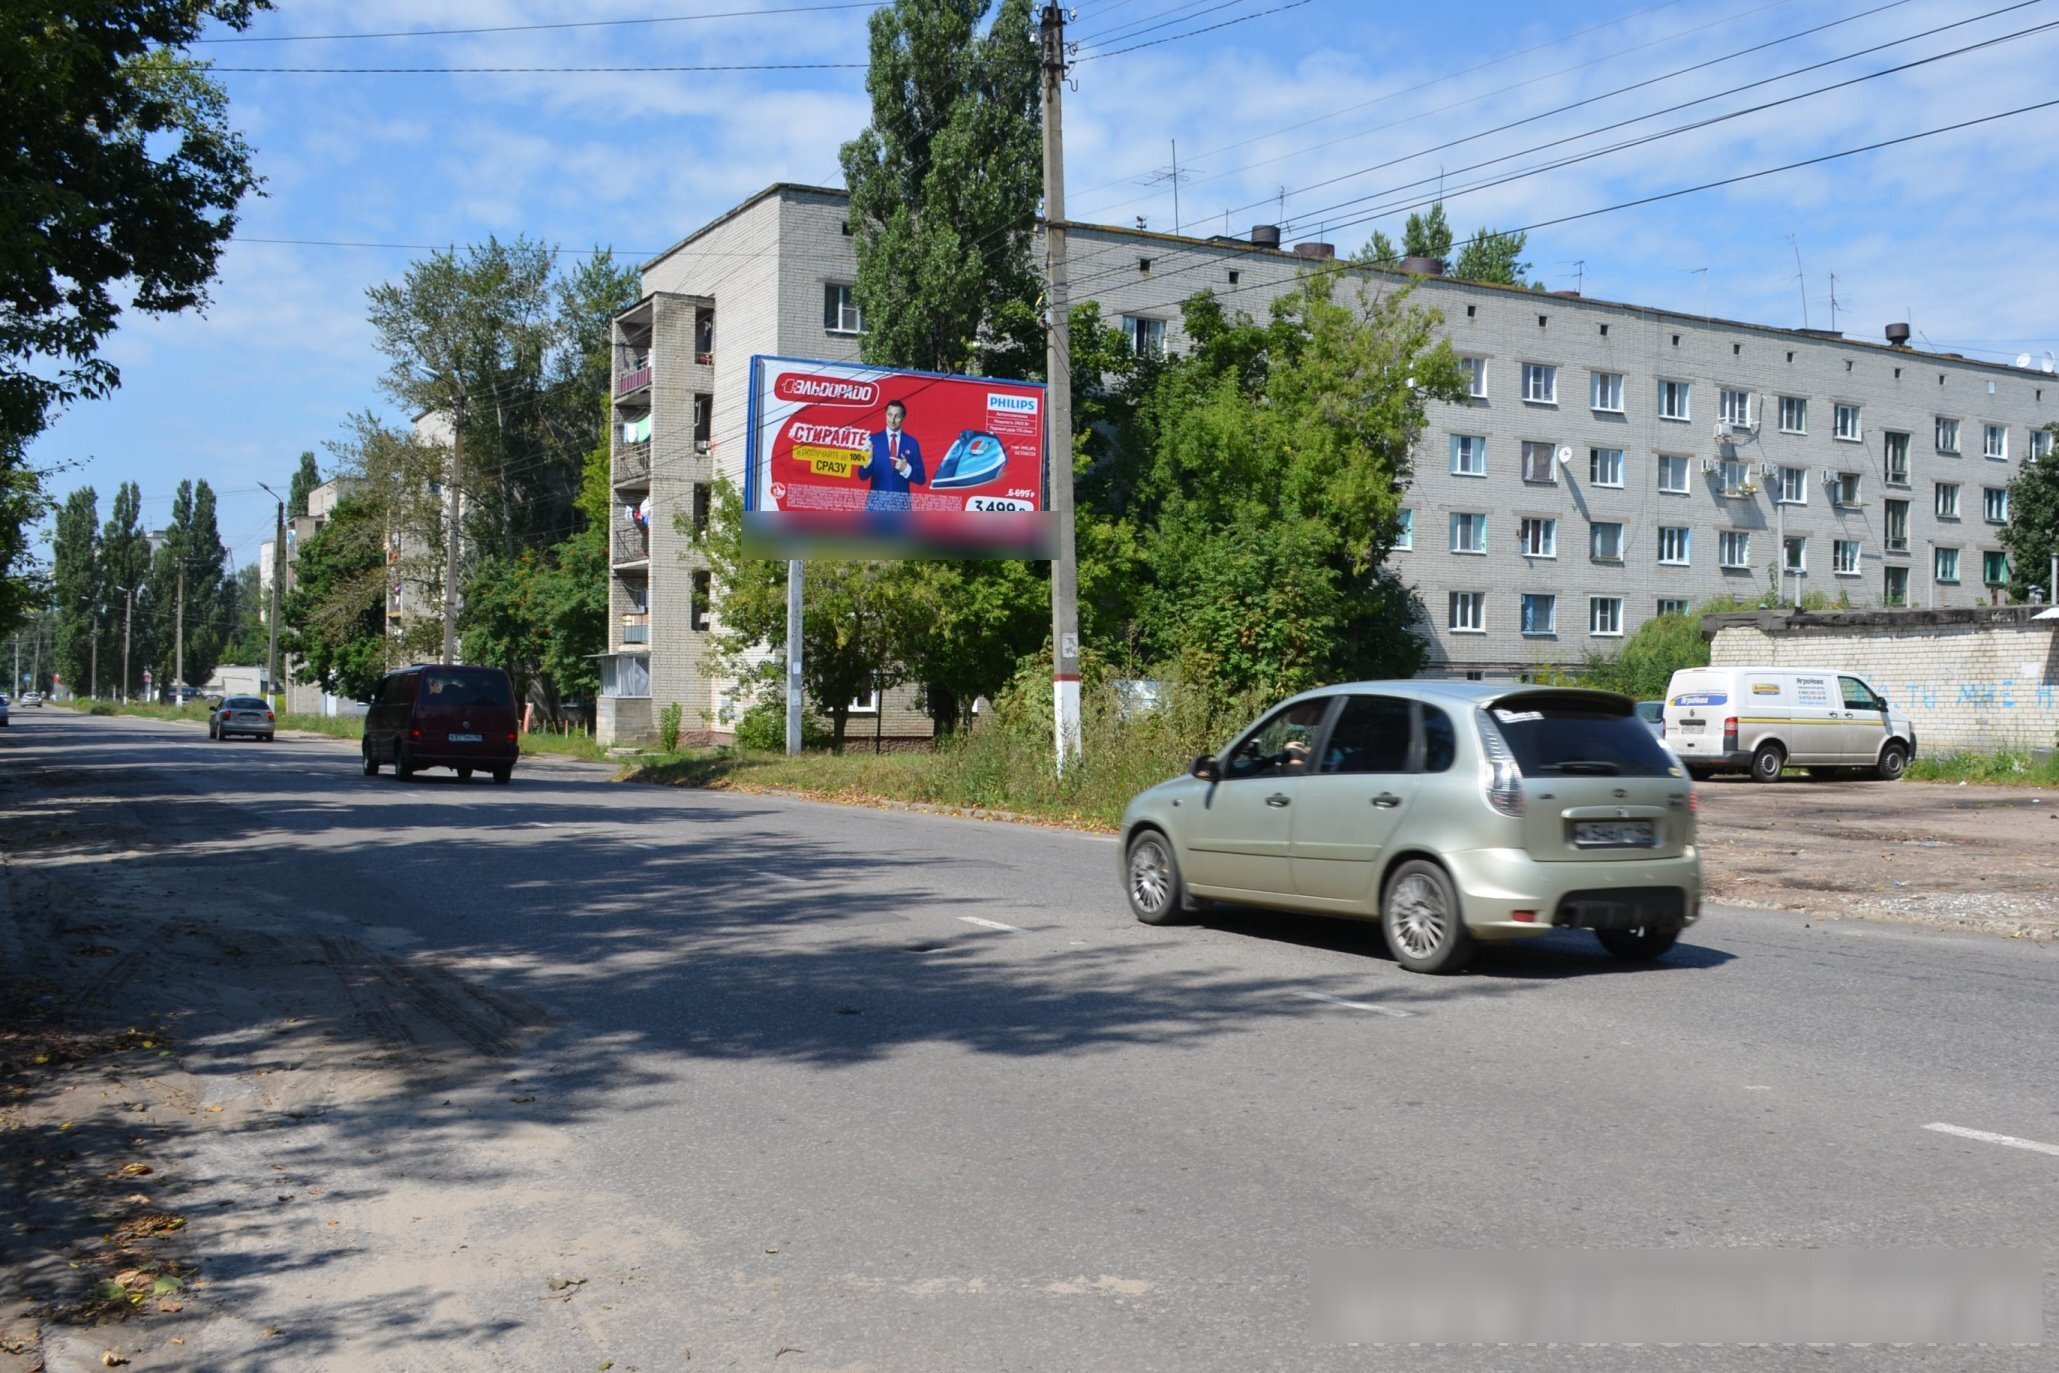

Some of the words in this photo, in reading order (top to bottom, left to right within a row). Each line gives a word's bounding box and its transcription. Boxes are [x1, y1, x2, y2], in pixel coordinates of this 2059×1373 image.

[793, 379, 872, 401] ЭЛЬДОРАДО
[990, 397, 1035, 410] PHILIPS
[795, 426, 867, 446] СТИРАЙТЕ
[816, 460, 847, 474] СРАЗУ
